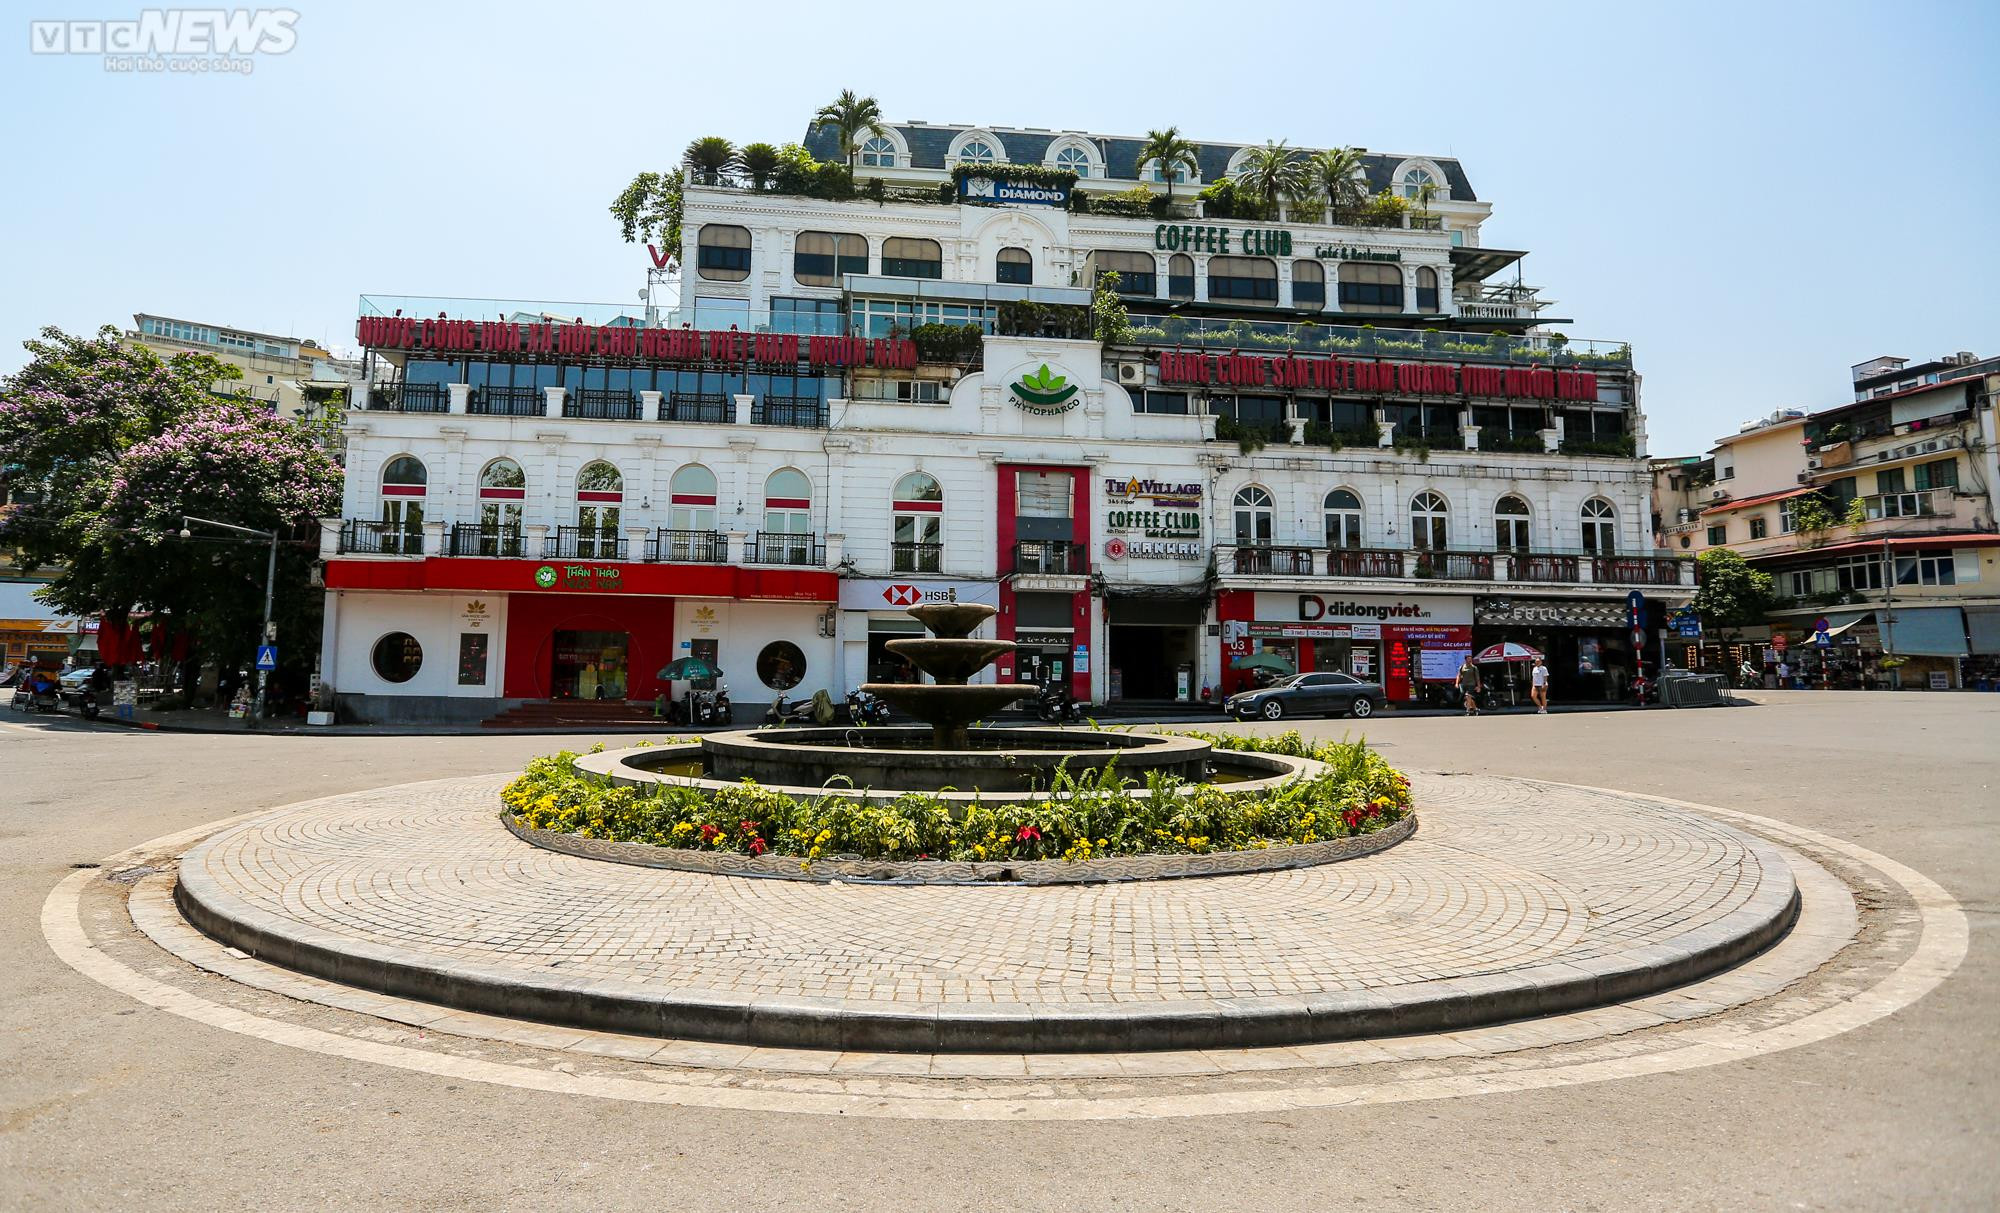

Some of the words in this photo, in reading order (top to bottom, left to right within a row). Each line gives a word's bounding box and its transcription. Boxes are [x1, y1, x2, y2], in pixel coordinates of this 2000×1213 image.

[999, 189, 1065, 201] DIAMOND
[1155, 224, 1230, 253] COFFEE
[1242, 229, 1292, 256] CLUB
[1341, 247, 1348, 260] &
[1351, 248, 1402, 261] Restaurant
[421, 311, 476, 358] CỘNG
[480, 313, 521, 353] HÒA
[527, 316, 554, 355] XÃ
[558, 317, 592, 362] HỘI
[642, 322, 701, 359] NGHĨA
[709, 324, 749, 370] VIỆT
[754, 333, 799, 365] NAM
[809, 330, 866, 367] MUÔN
[1159, 343, 1211, 385] ĐẢNG
[1216, 348, 1266, 391] CỘNG
[1272, 348, 1310, 389] SẢN
[1312, 353, 1350, 395] VIỆT
[1353, 361, 1395, 392] NAM
[1399, 363, 1456, 396] QUANG
[1460, 365, 1501, 398] VINH
[1504, 362, 1555, 399] MUÔN
[1008, 396, 1080, 416] PHYTOPHARCO
[1108, 511, 1160, 528] COFFEE
[1165, 512, 1200, 529] CLUB
[1129, 541, 1200, 555] MANWAH
[563, 564, 590, 578] THÂN
[593, 565, 619, 578] THẢO
[925, 591, 957, 601] HSB
